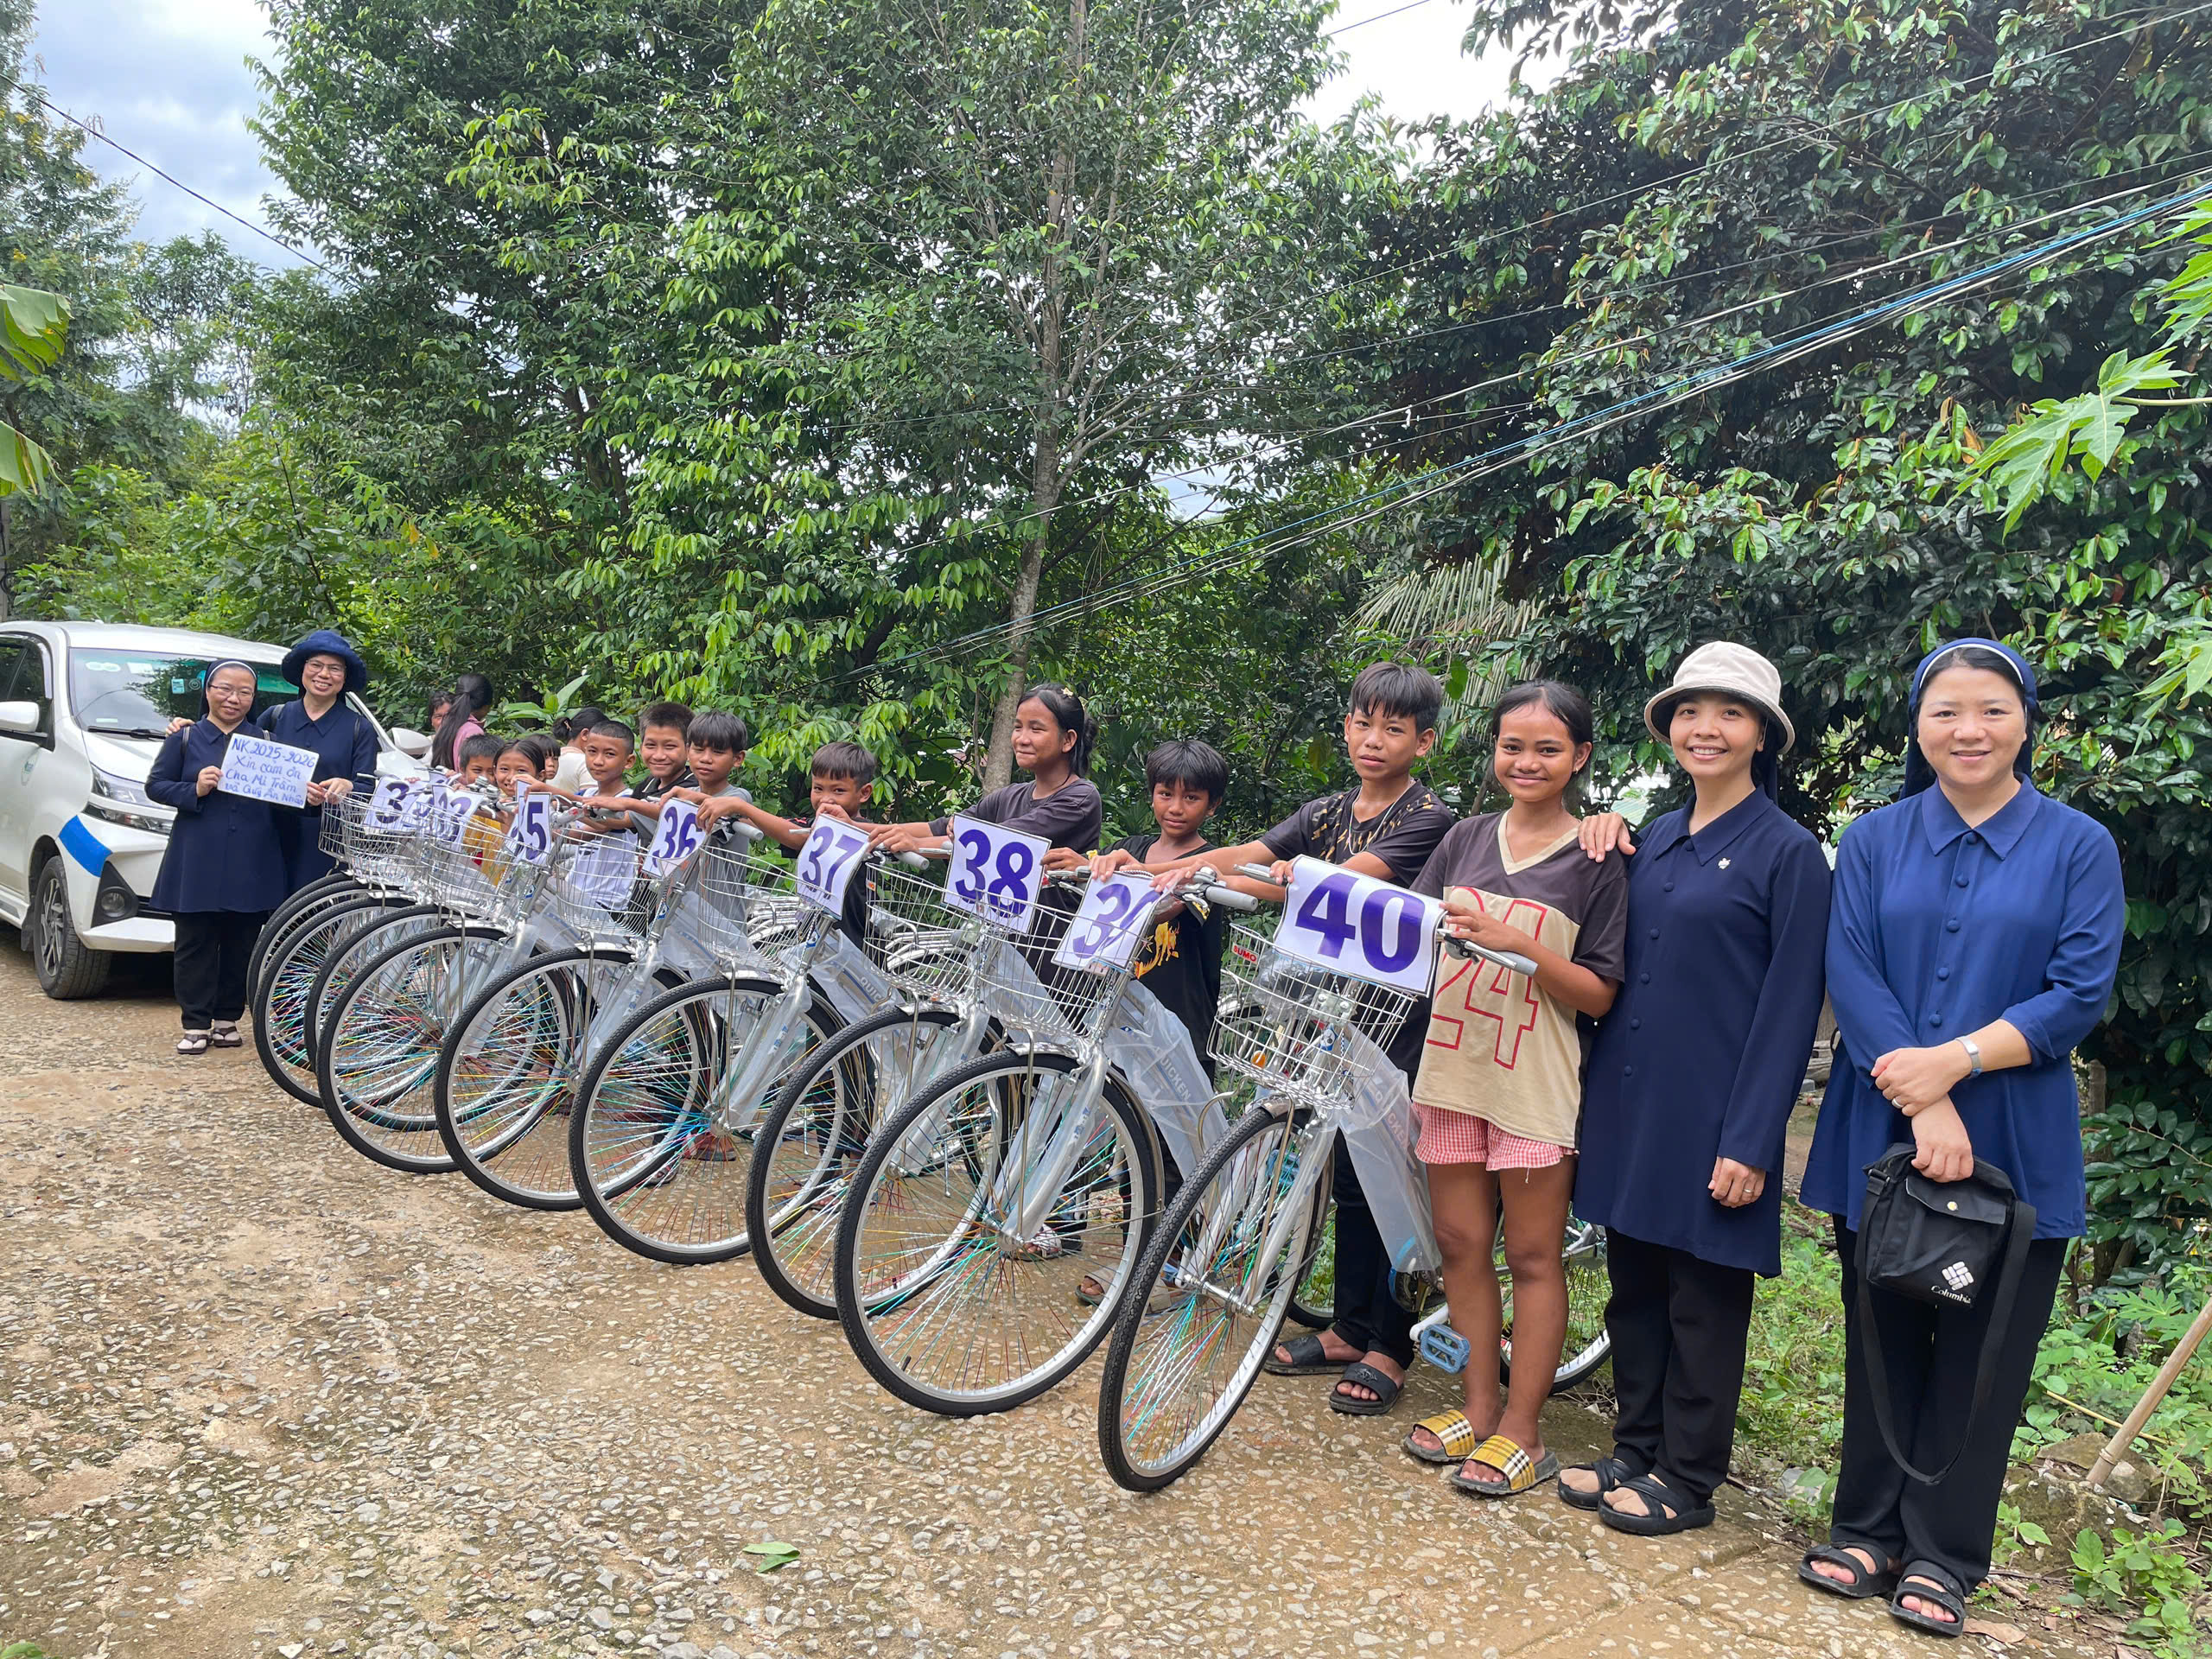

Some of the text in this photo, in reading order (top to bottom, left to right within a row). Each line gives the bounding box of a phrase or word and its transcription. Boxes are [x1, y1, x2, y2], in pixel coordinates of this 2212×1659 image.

[232, 738, 316, 767] NK 2025-2026
[234, 754, 256, 770] Xin
[226, 768, 248, 782] Cha
[652, 806, 703, 868] 36
[802, 826, 864, 899] 37
[955, 829, 1034, 918] 38
[1295, 872, 1425, 974] 40
[1233, 944, 1257, 962] SUMO
[1160, 1056, 1191, 1100] UICKEN
[1930, 1285, 1971, 1304] Columbia
